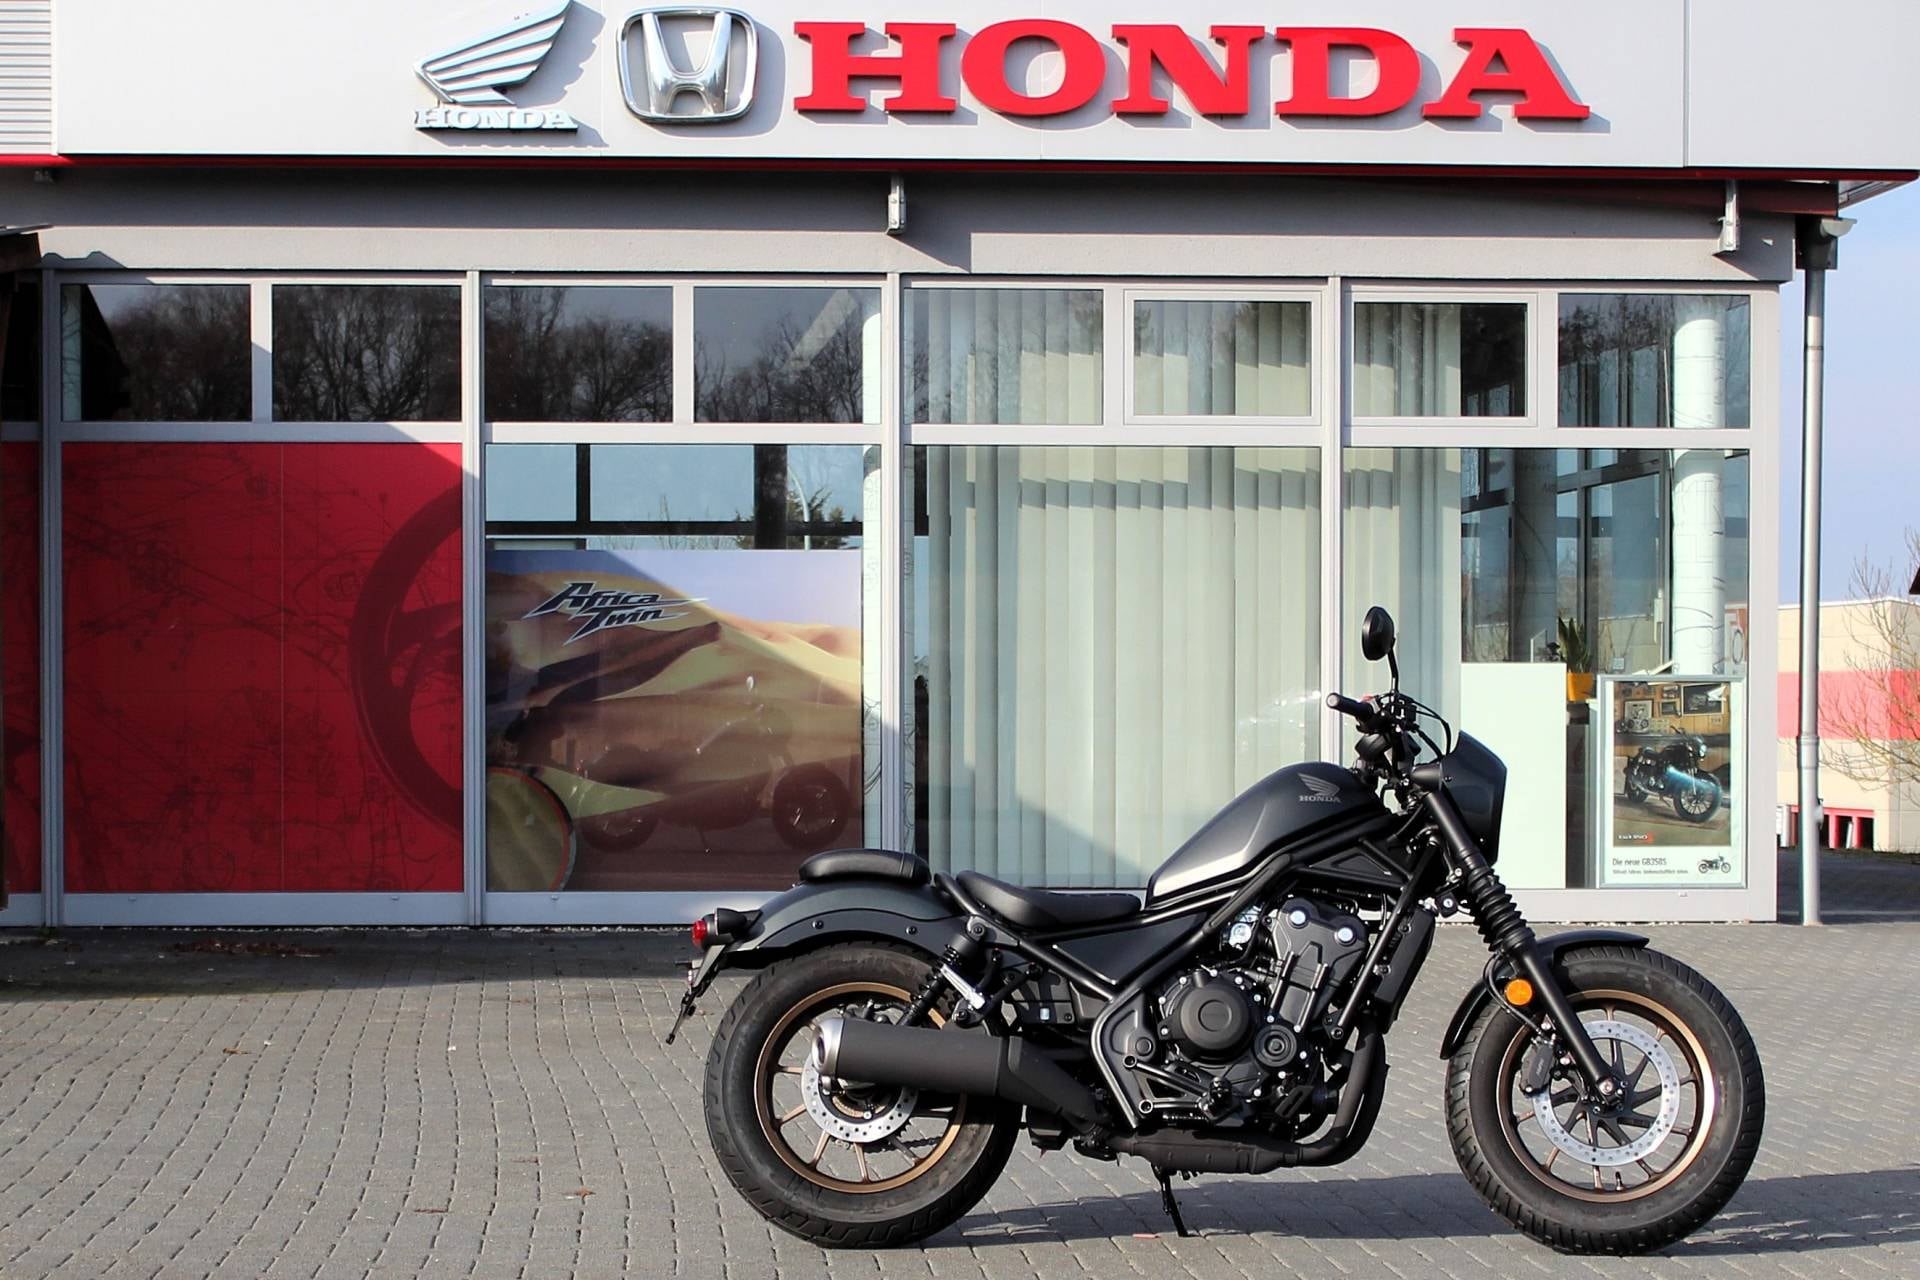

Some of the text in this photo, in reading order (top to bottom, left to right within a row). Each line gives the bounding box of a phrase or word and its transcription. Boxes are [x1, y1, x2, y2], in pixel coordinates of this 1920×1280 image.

[793, 19, 1590, 120] HONDA
[415, 107, 578, 130] HONDA
[522, 580, 706, 620] Africa
[562, 606, 687, 647] Twin
[1299, 795, 1341, 803] HONDA
[1612, 858, 1623, 866] Die
